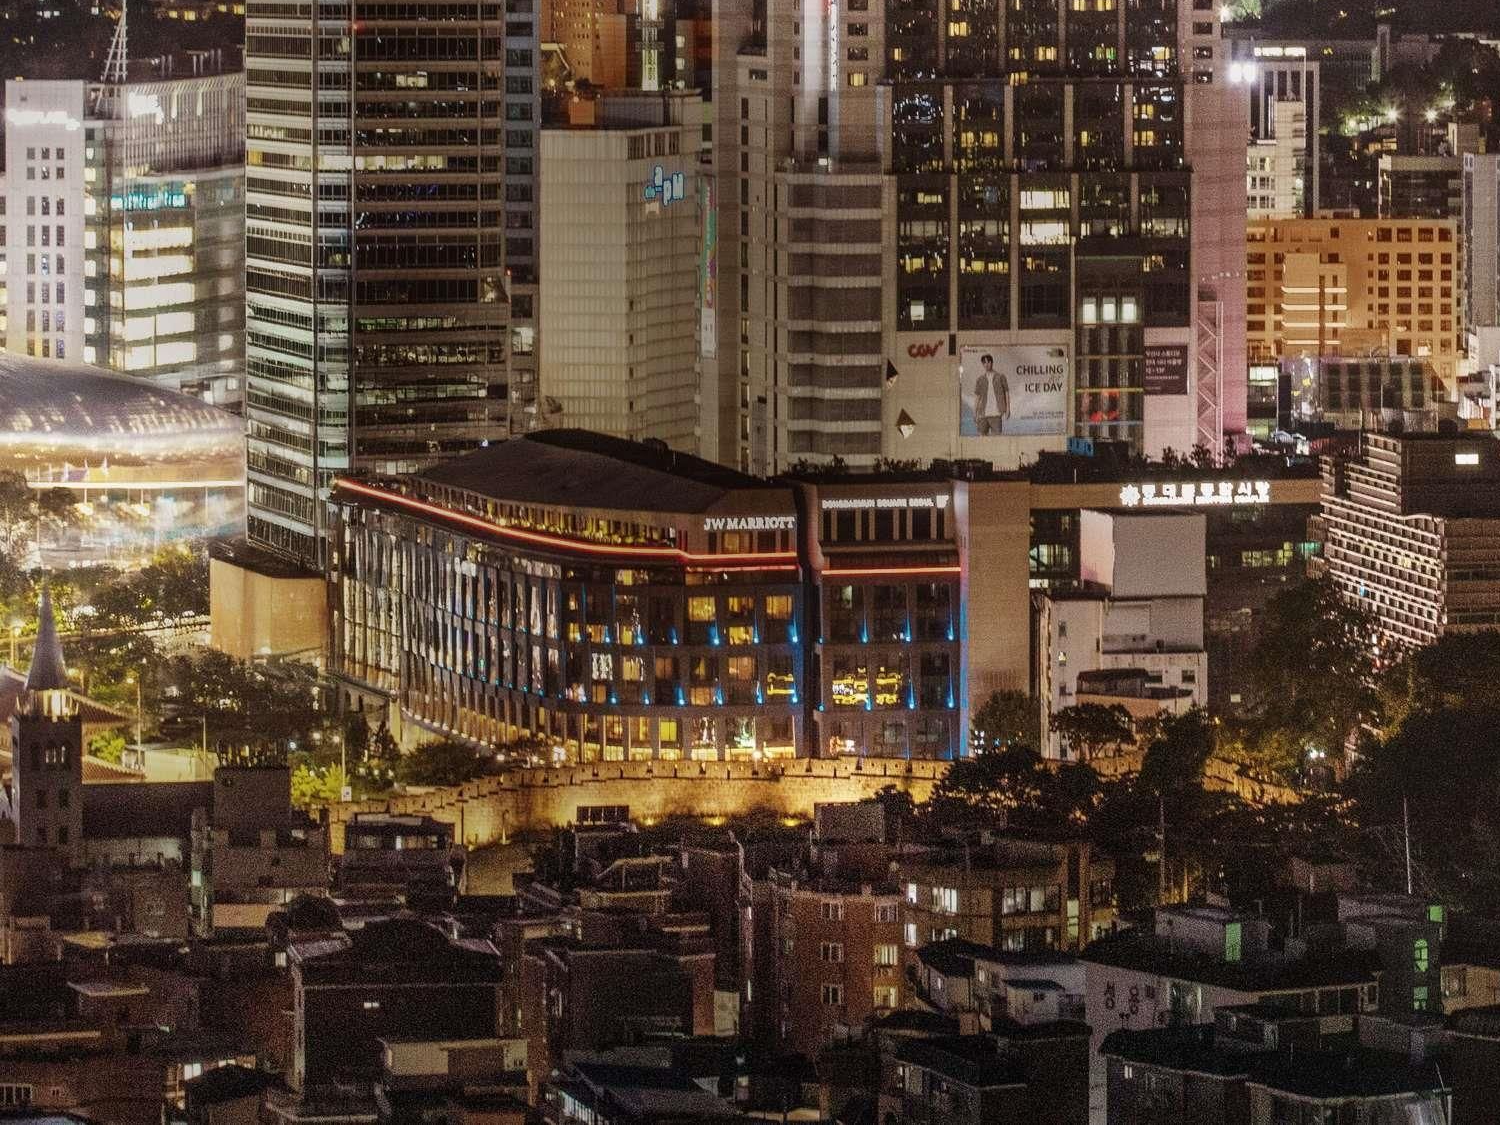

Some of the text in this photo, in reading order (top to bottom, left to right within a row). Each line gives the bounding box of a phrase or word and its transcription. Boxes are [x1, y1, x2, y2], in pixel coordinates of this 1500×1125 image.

[907, 343, 938, 358] CGV
[1016, 365, 1064, 375] CHILLING
[1025, 383, 1063, 393] ICE DAY
[876, 499, 907, 508] SQUARE
[908, 498, 934, 507] SEOUL
[704, 516, 795, 530] JW MARRIOTT
